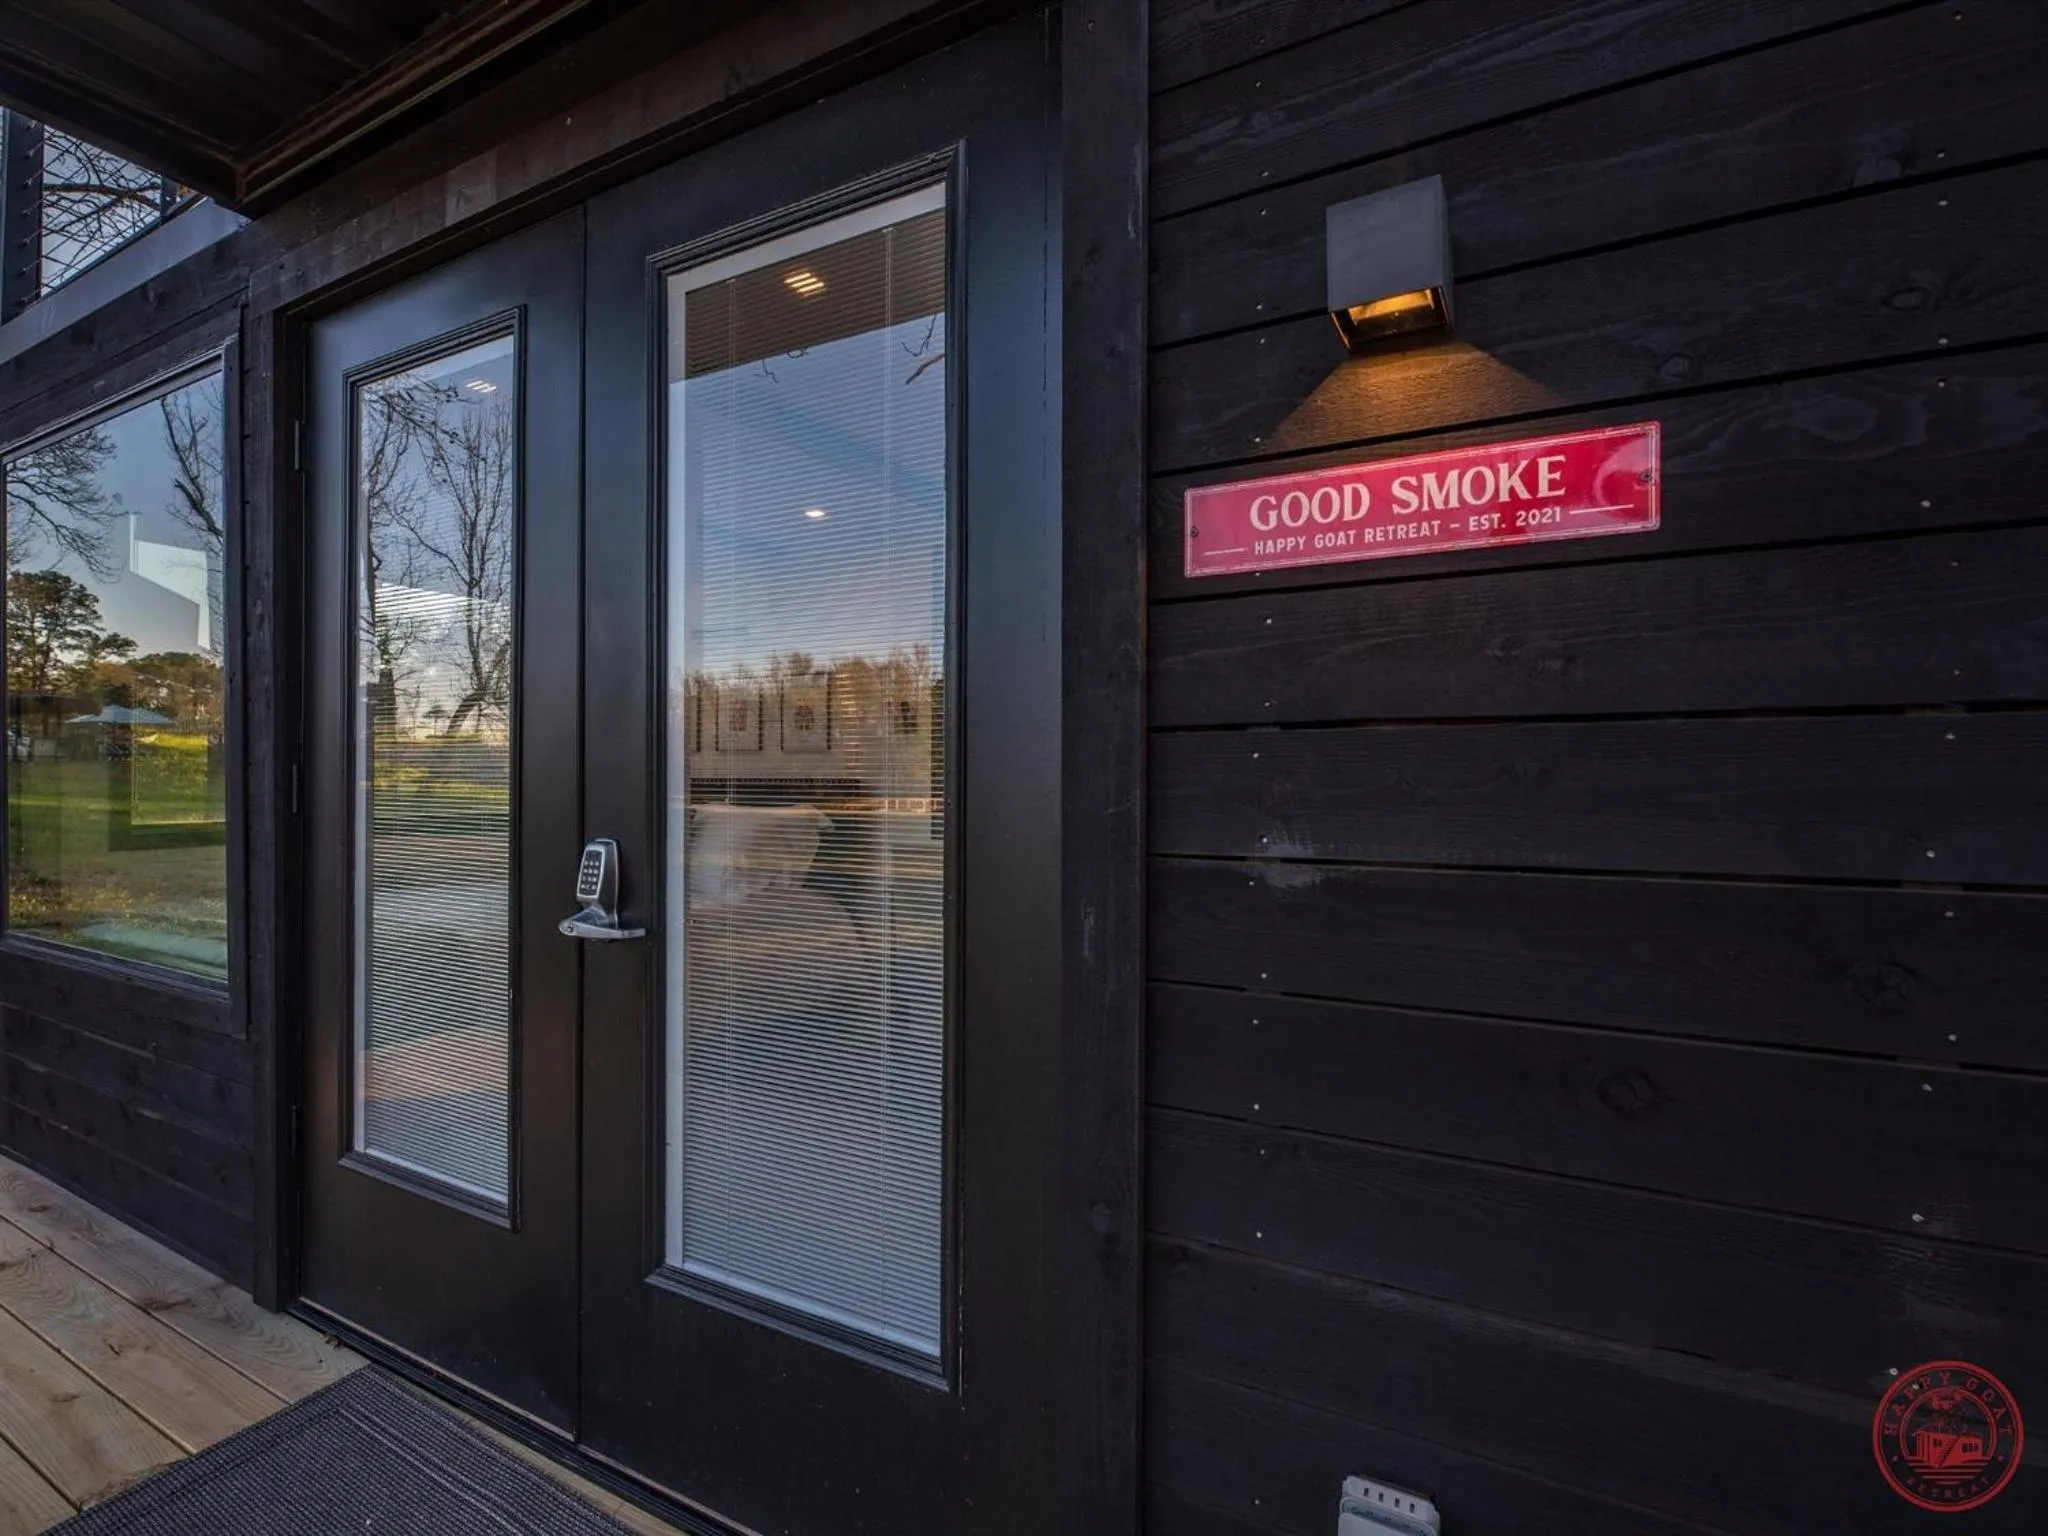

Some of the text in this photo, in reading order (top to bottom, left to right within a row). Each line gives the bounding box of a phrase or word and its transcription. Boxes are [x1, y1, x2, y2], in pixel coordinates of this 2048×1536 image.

[1249, 454, 1567, 531] GOOD SMOKE
[1254, 535, 1308, 555] HAPPY
[1314, 530, 1357, 549] GOAT
[1364, 520, 1442, 544] RETREAT
[1468, 512, 1507, 532] EST.
[1515, 507, 1562, 527] 2021
